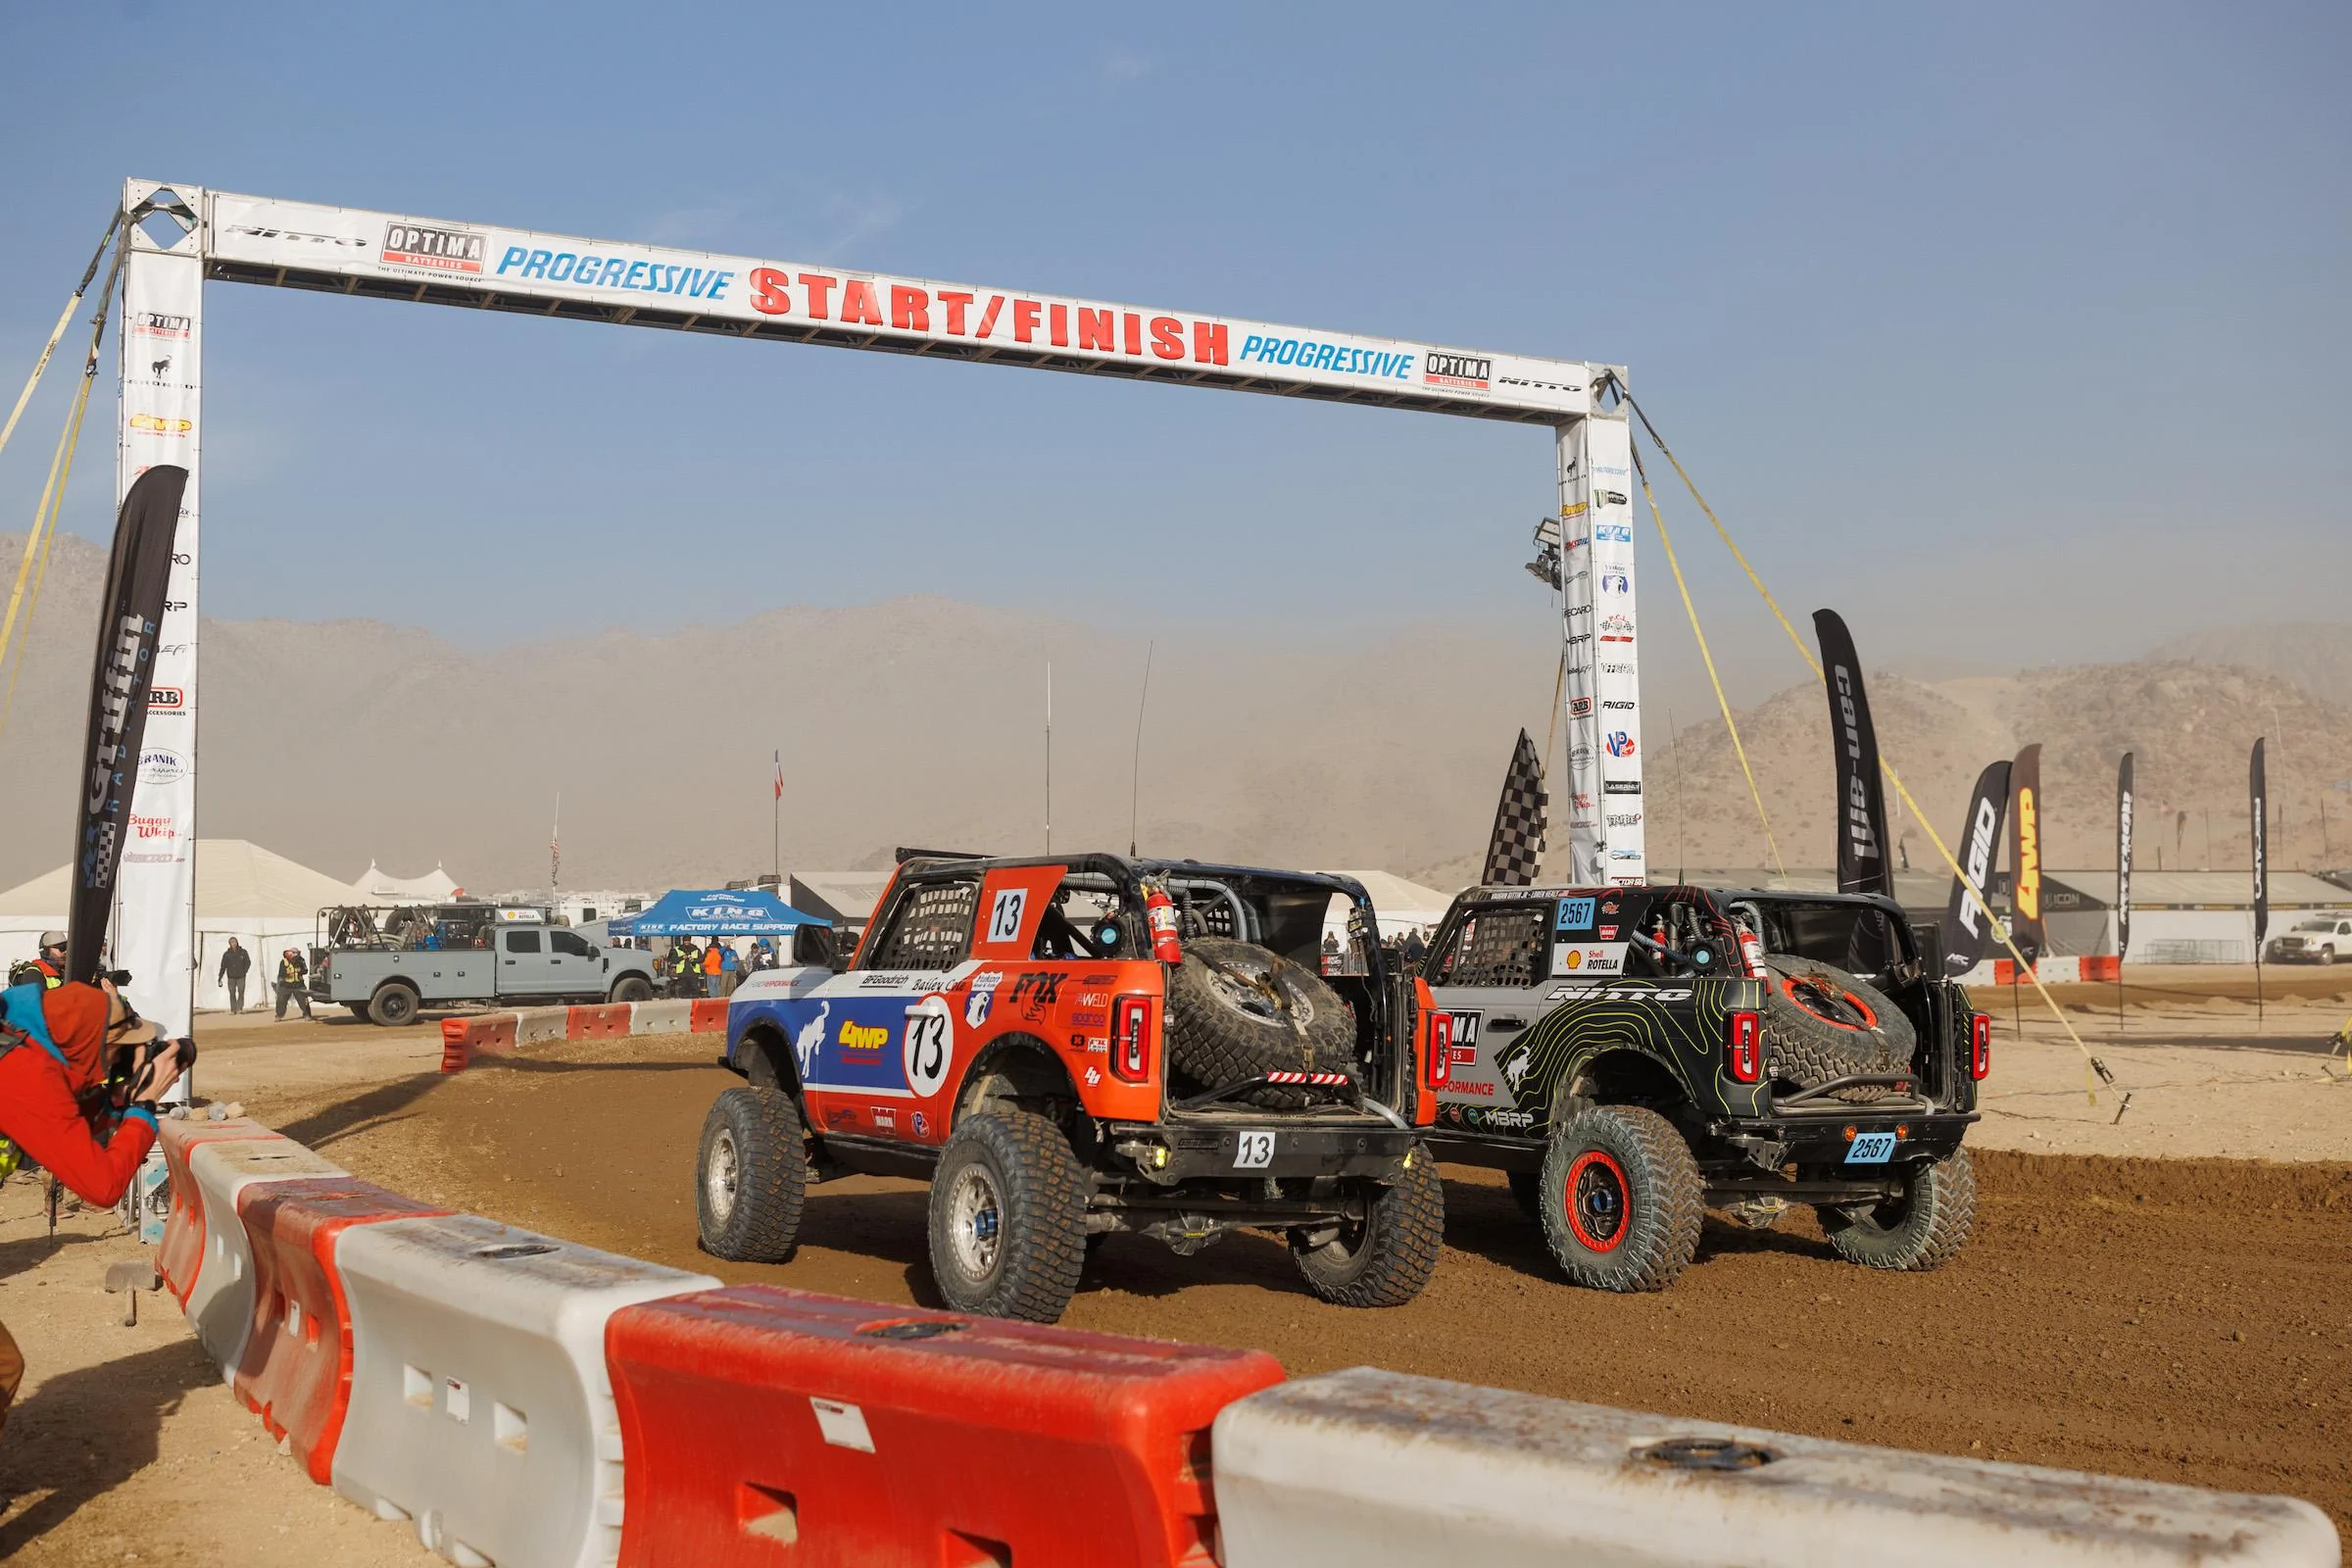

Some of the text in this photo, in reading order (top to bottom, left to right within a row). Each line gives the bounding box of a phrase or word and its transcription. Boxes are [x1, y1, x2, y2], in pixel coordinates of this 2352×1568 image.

[389, 228, 481, 259] OPTIMA
[393, 268, 424, 276] ULTIMATE
[405, 255, 463, 270] BATTERIES
[497, 246, 734, 300] PROGRESSIVE
[137, 314, 190, 331] OPTIMA
[750, 268, 1229, 366] START/FINISH
[1240, 335, 1414, 379] PROGRESSIVE
[1427, 354, 1490, 379] OPTIMA
[1439, 376, 1477, 388] BATTERIES
[1498, 376, 1582, 392] NITTO
[89, 612, 145, 815] Griffin
[106, 620, 156, 812] RADATOR
[1602, 702, 1635, 710] RIGID
[1608, 731, 1627, 758] VP
[138, 826, 175, 841] Whip
[2017, 787, 2039, 920] 4WP
[1959, 796, 1996, 941] RIGID
[691, 906, 764, 917] KING
[996, 895, 1021, 936] 13
[1561, 903, 1591, 924] 2567
[1589, 950, 1603, 958] Shell
[1588, 959, 1618, 970] ROTELLA
[912, 979, 942, 992] Bailey
[1008, 971, 1068, 1004] FOX
[1545, 986, 1693, 1002] NITTO
[1082, 993, 1108, 1007] WELD
[838, 1019, 889, 1051] 4WP
[912, 1014, 946, 1079] 13
[1438, 1080, 1494, 1096] RFORMANCE
[1485, 1110, 1535, 1128] MBRP
[1243, 1136, 1270, 1164] 13
[1852, 1138, 1892, 1157] 2567
